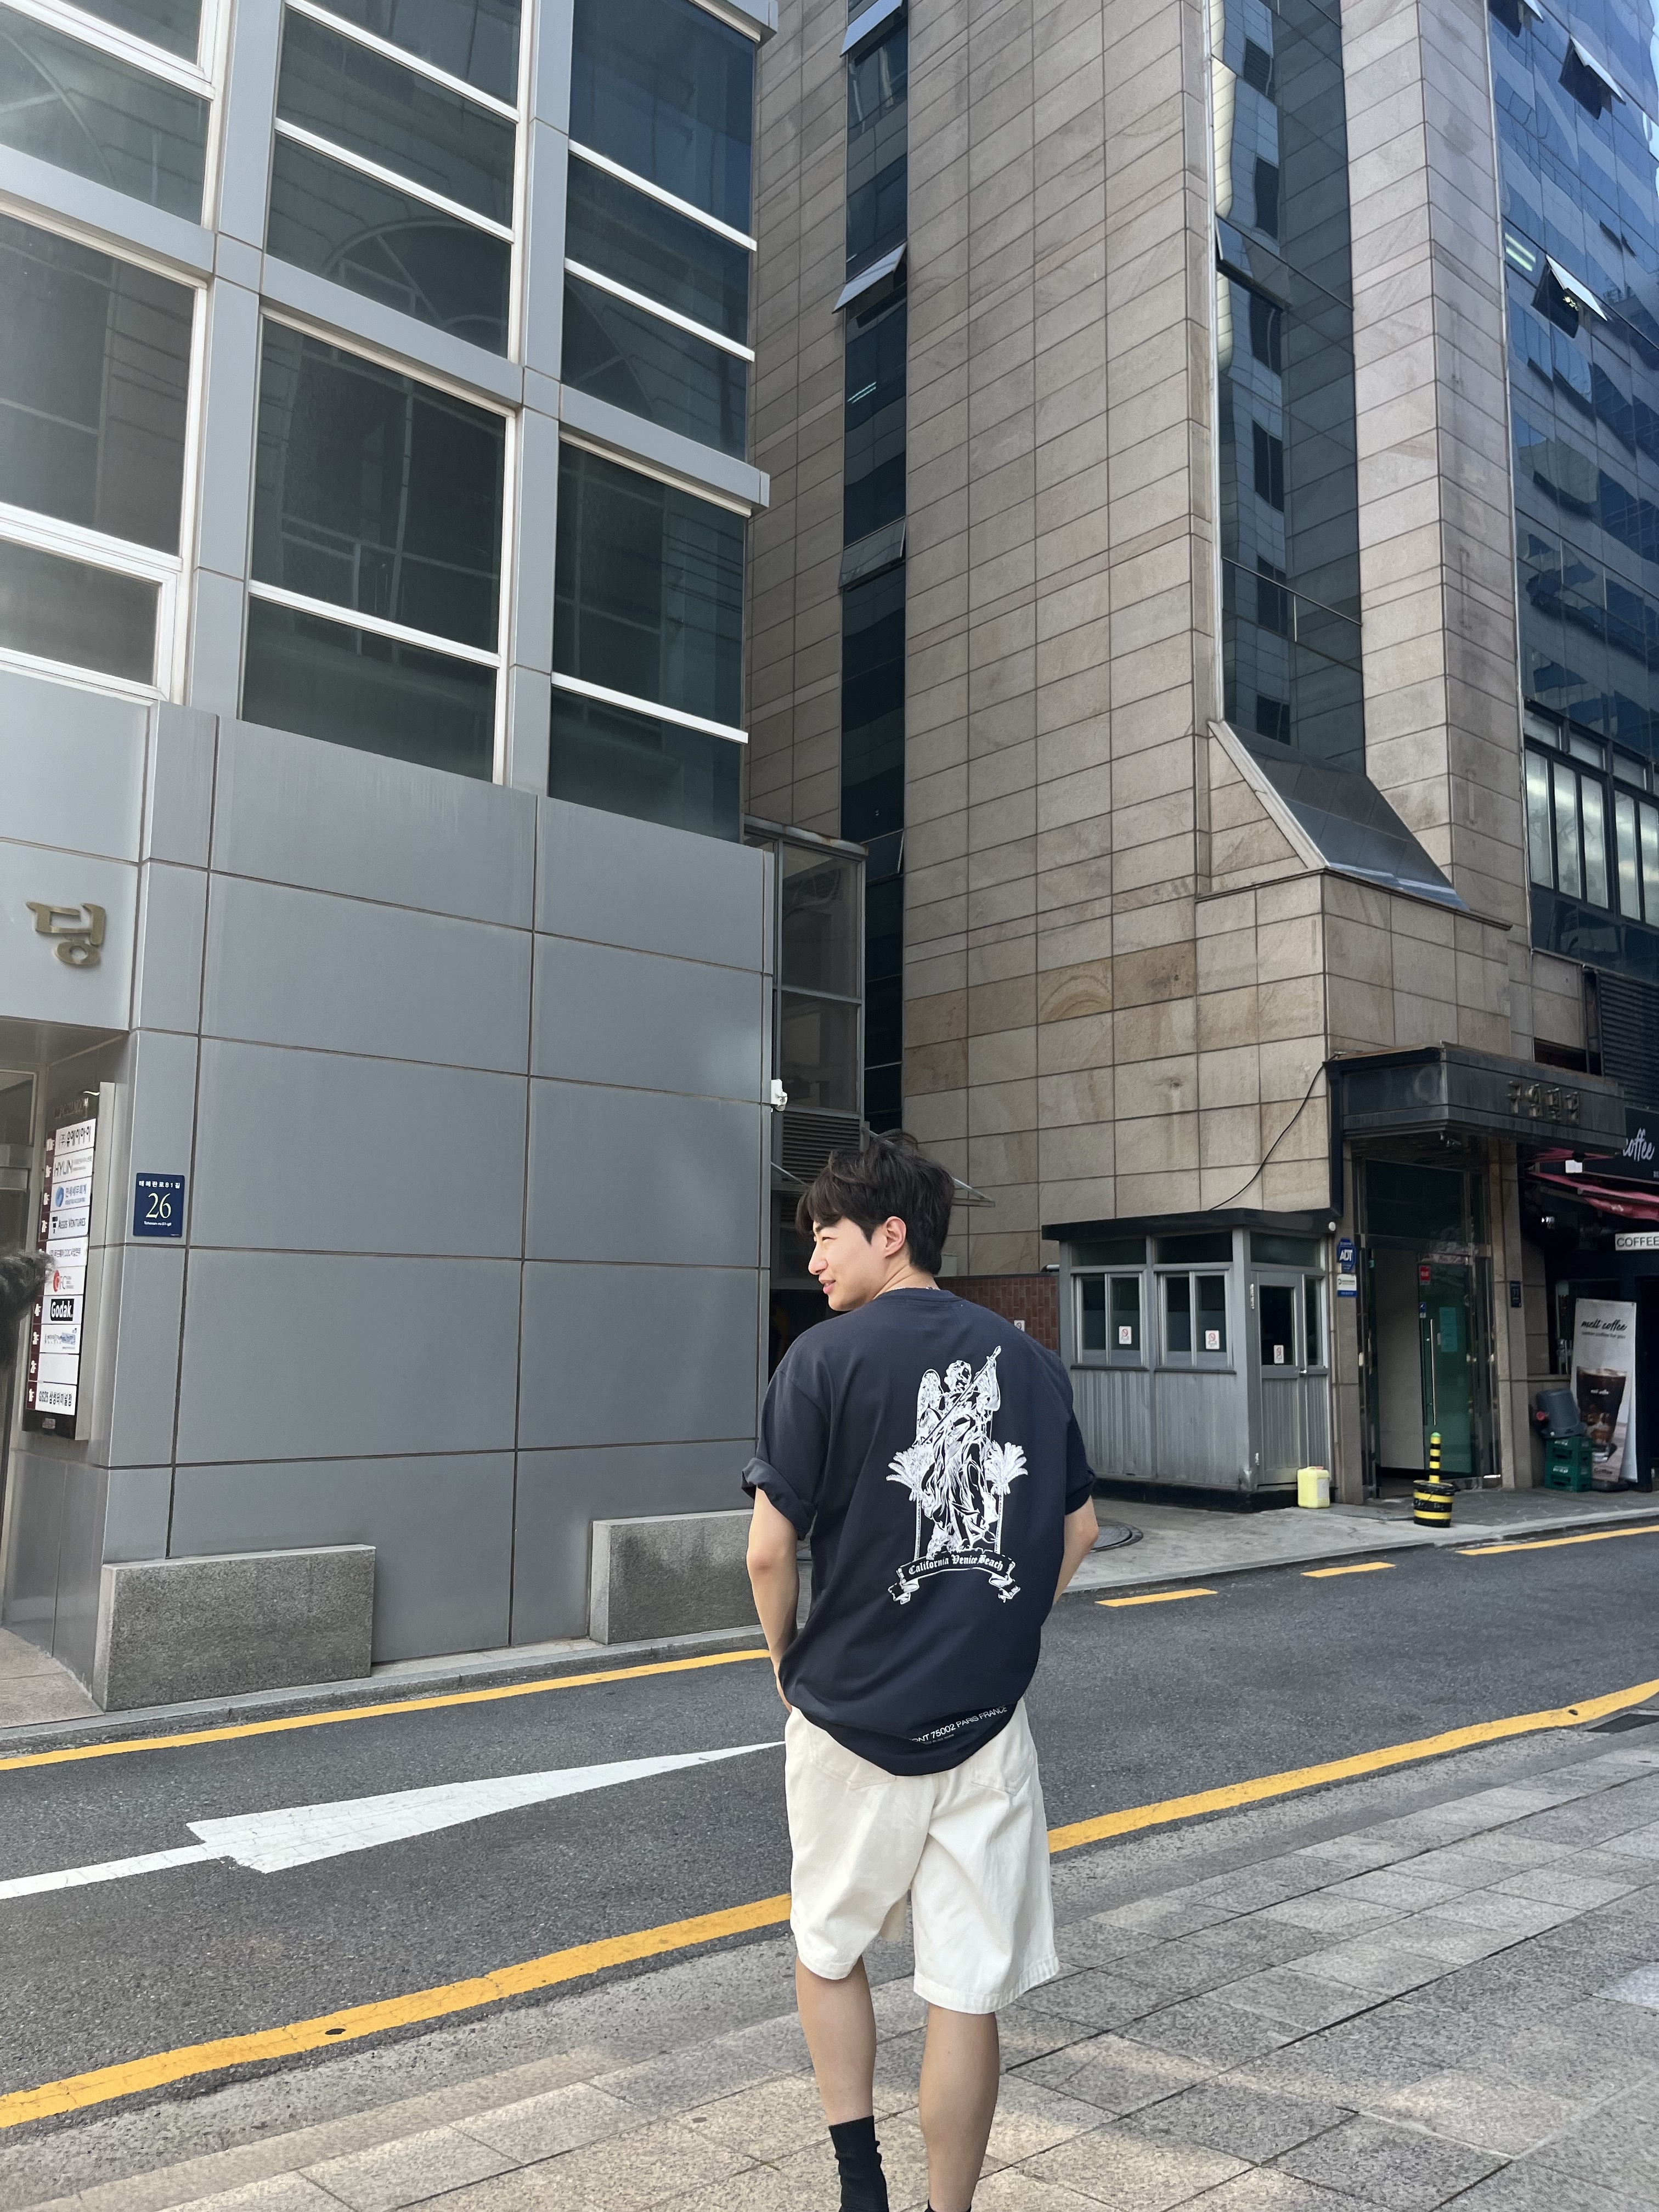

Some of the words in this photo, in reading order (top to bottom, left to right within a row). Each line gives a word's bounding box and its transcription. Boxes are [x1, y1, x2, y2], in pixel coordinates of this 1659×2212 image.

[26, 901, 106, 966] 딩
[145, 1193, 171, 1218] 26
[1616, 1235, 1659, 1248] COFFEE
[1339, 1249, 1353, 1261] ADT
[1581, 1318, 1601, 1329] melt
[1601, 1319, 1628, 1331] coffee
[909, 1556, 949, 1575] California
[951, 1554, 978, 1565] Venice
[979, 1554, 1003, 1571] Beach
[930, 1724, 956, 1739] 75002
[956, 1716, 979, 1728] PARIS
[978, 1706, 1007, 1720] FRANCE
